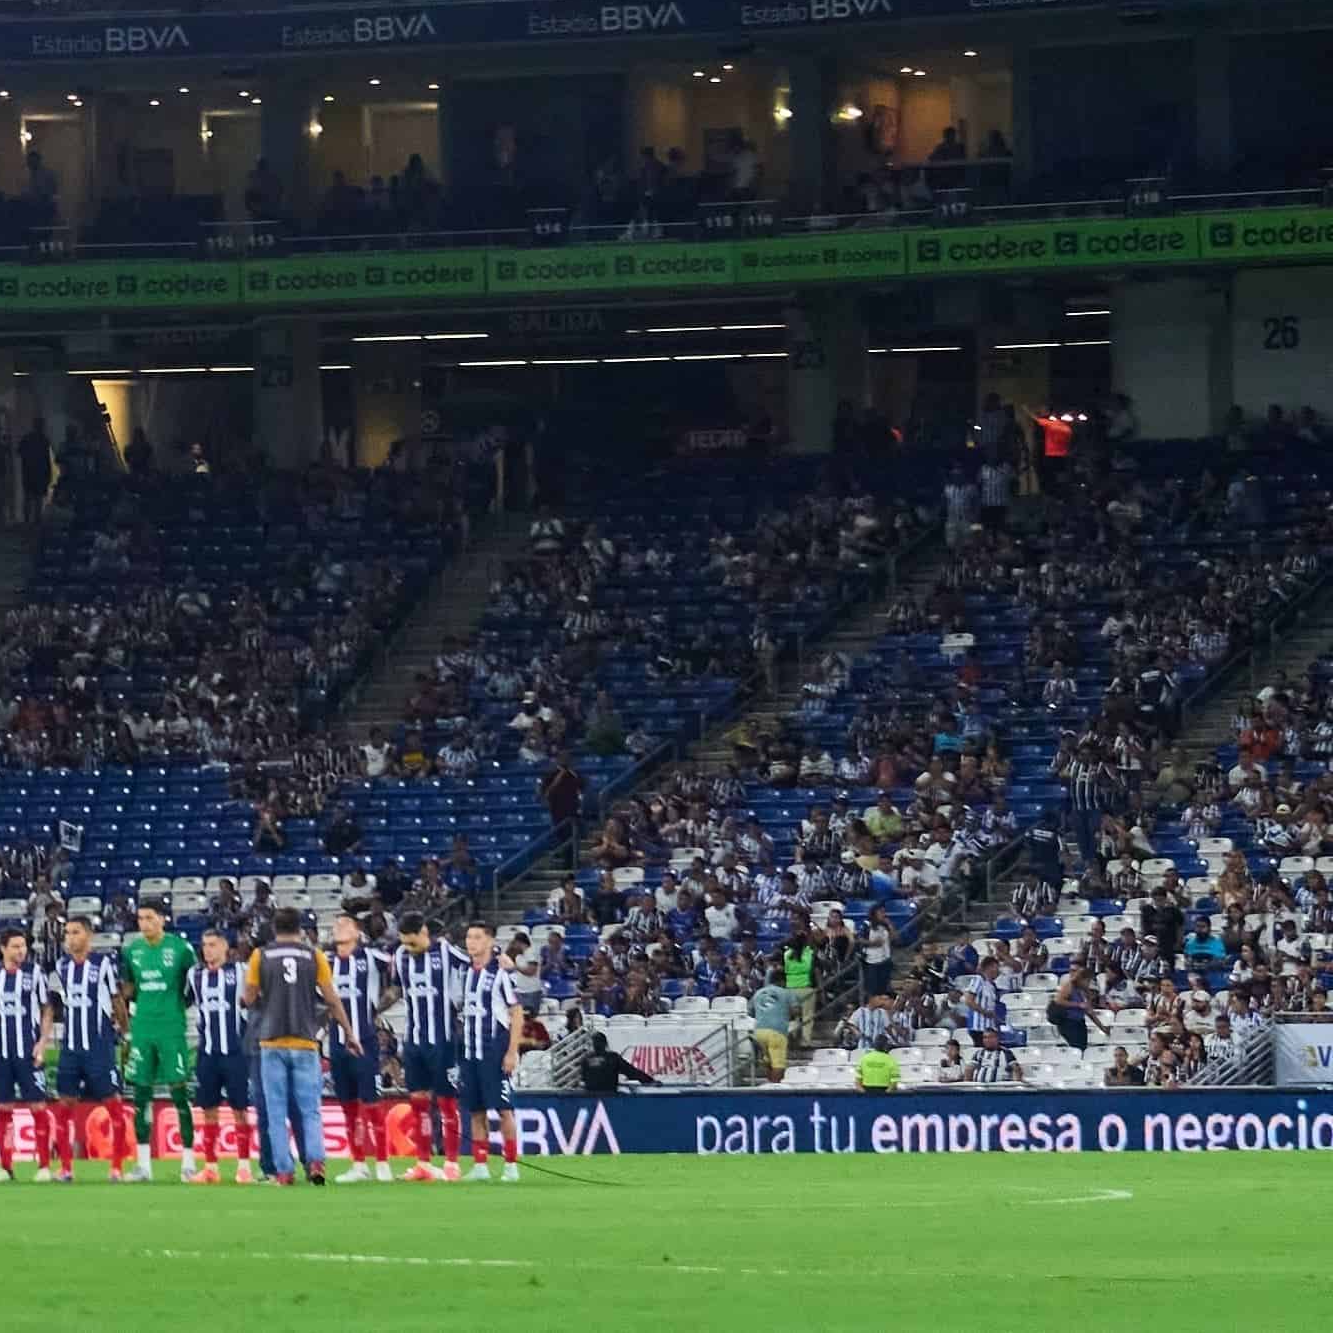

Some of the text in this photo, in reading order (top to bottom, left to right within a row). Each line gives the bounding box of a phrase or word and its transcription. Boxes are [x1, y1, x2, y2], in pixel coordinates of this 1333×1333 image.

[353, 13, 436, 42] BBVA
[600, 2, 685, 31] BBVA
[105, 25, 189, 53] BBVA
[1086, 228, 1186, 254] codere
[1242, 220, 1333, 248] codere
[641, 250, 726, 274] codere
[948, 235, 1047, 262] codere
[276, 268, 357, 290] codere
[392, 261, 475, 284] codere
[524, 256, 606, 280] codere
[26, 274, 110, 296] codere
[144, 273, 229, 295] codere
[1264, 315, 1299, 350] 26
[282, 957, 298, 984] 3
[696, 1113, 795, 1154] para
[810, 1101, 855, 1148] tu
[872, 1112, 1082, 1152] empresa
[1097, 1113, 1127, 1151] o
[1145, 1098, 1333, 1152] negocio
